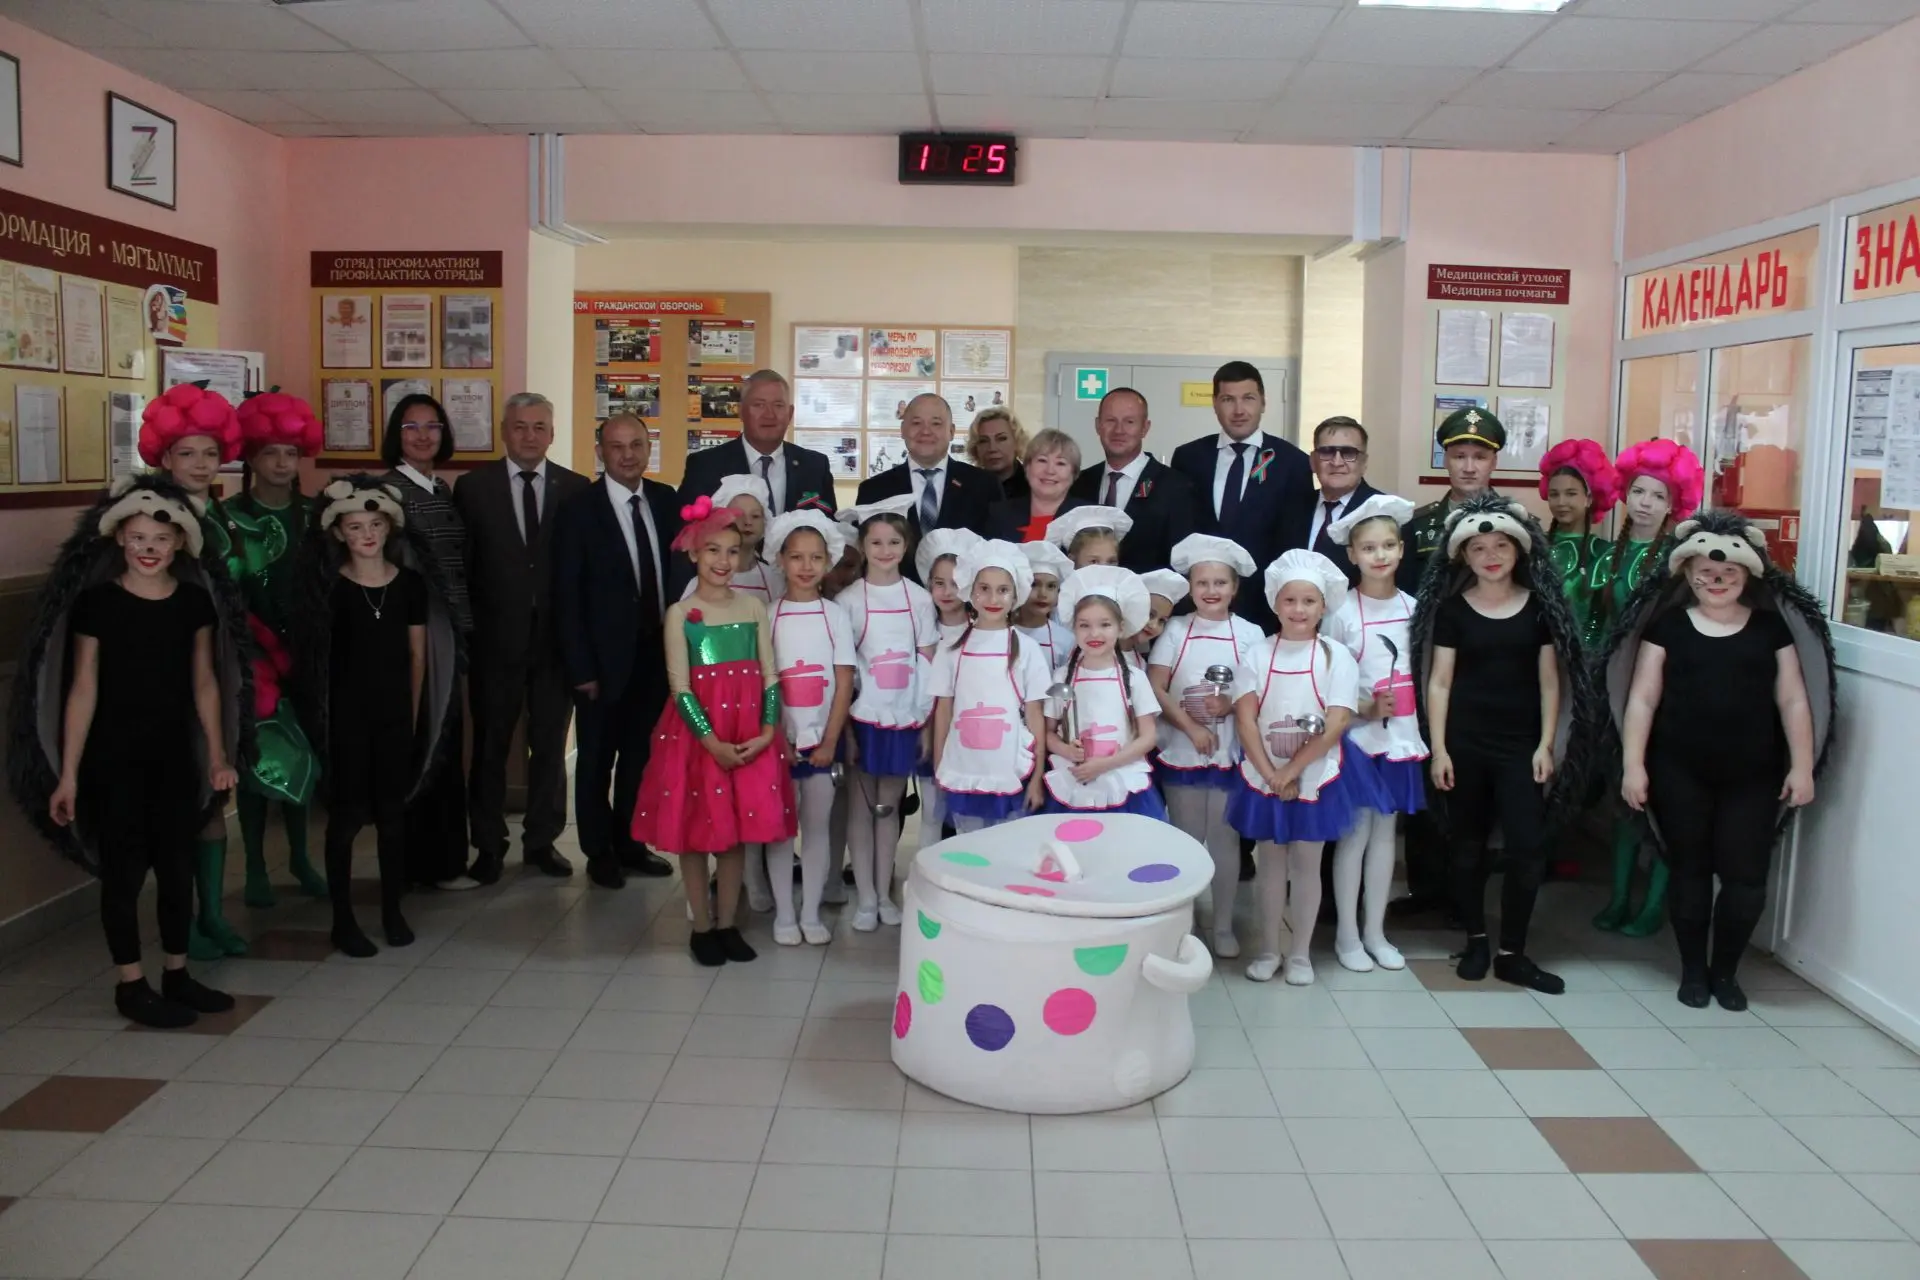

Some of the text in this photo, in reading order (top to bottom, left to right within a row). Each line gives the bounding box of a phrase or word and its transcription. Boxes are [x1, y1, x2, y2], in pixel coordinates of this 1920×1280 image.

[334, 257, 480, 270] ОТРЯД ПРОФИЛАКТИКИ
[330, 269, 485, 282] ПРОФИЛАКТИКА ОТРЯДЫ
[1436, 267, 1564, 285] Медицинский уголок
[1641, 213, 1920, 330] КАЛЕНДАРЬ ЗНА
[1441, 283, 1557, 299] Медицина почмагы
[594, 301, 656, 311] ГРАЖДАНСКОЙ
[659, 301, 704, 311] ОБОРОНЫ
